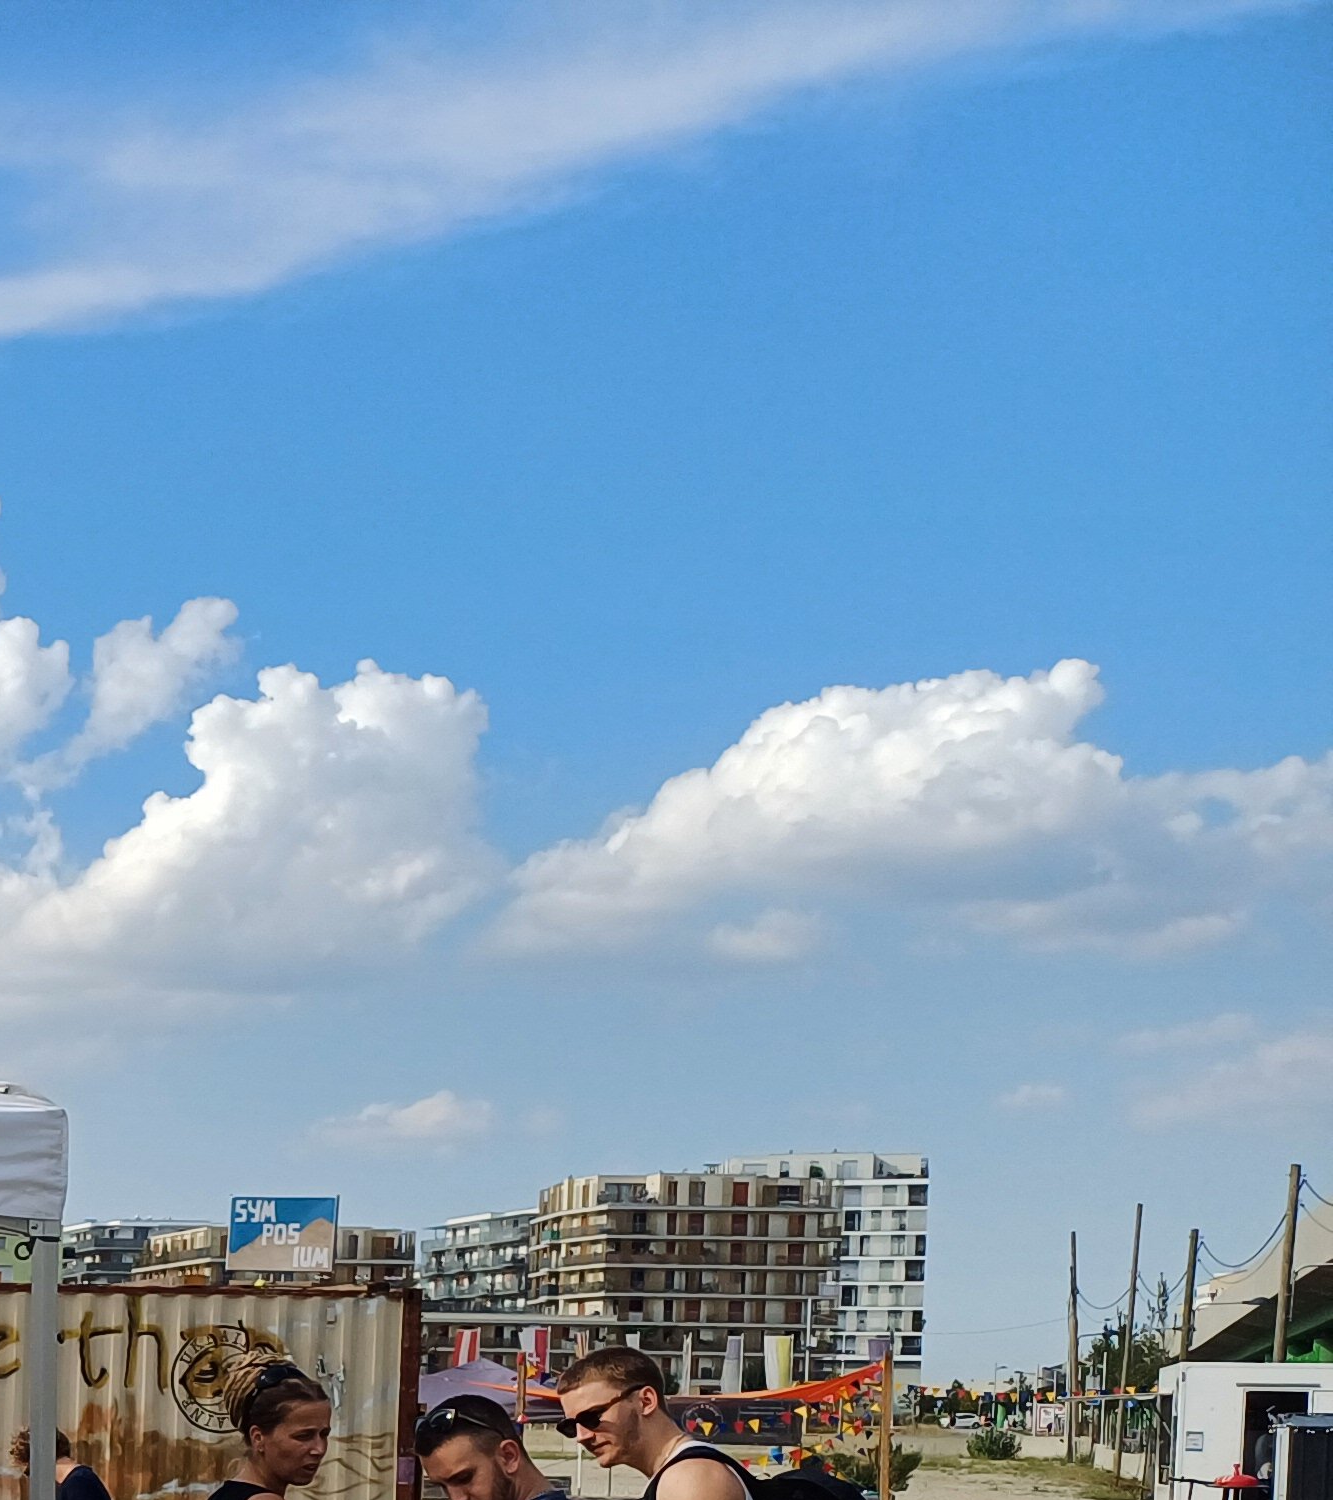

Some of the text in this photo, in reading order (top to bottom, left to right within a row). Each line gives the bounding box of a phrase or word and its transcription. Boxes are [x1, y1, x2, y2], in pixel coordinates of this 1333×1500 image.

[235, 1199, 276, 1223] SYM
[261, 1223, 301, 1246] POS
[293, 1246, 329, 1269] IUM
